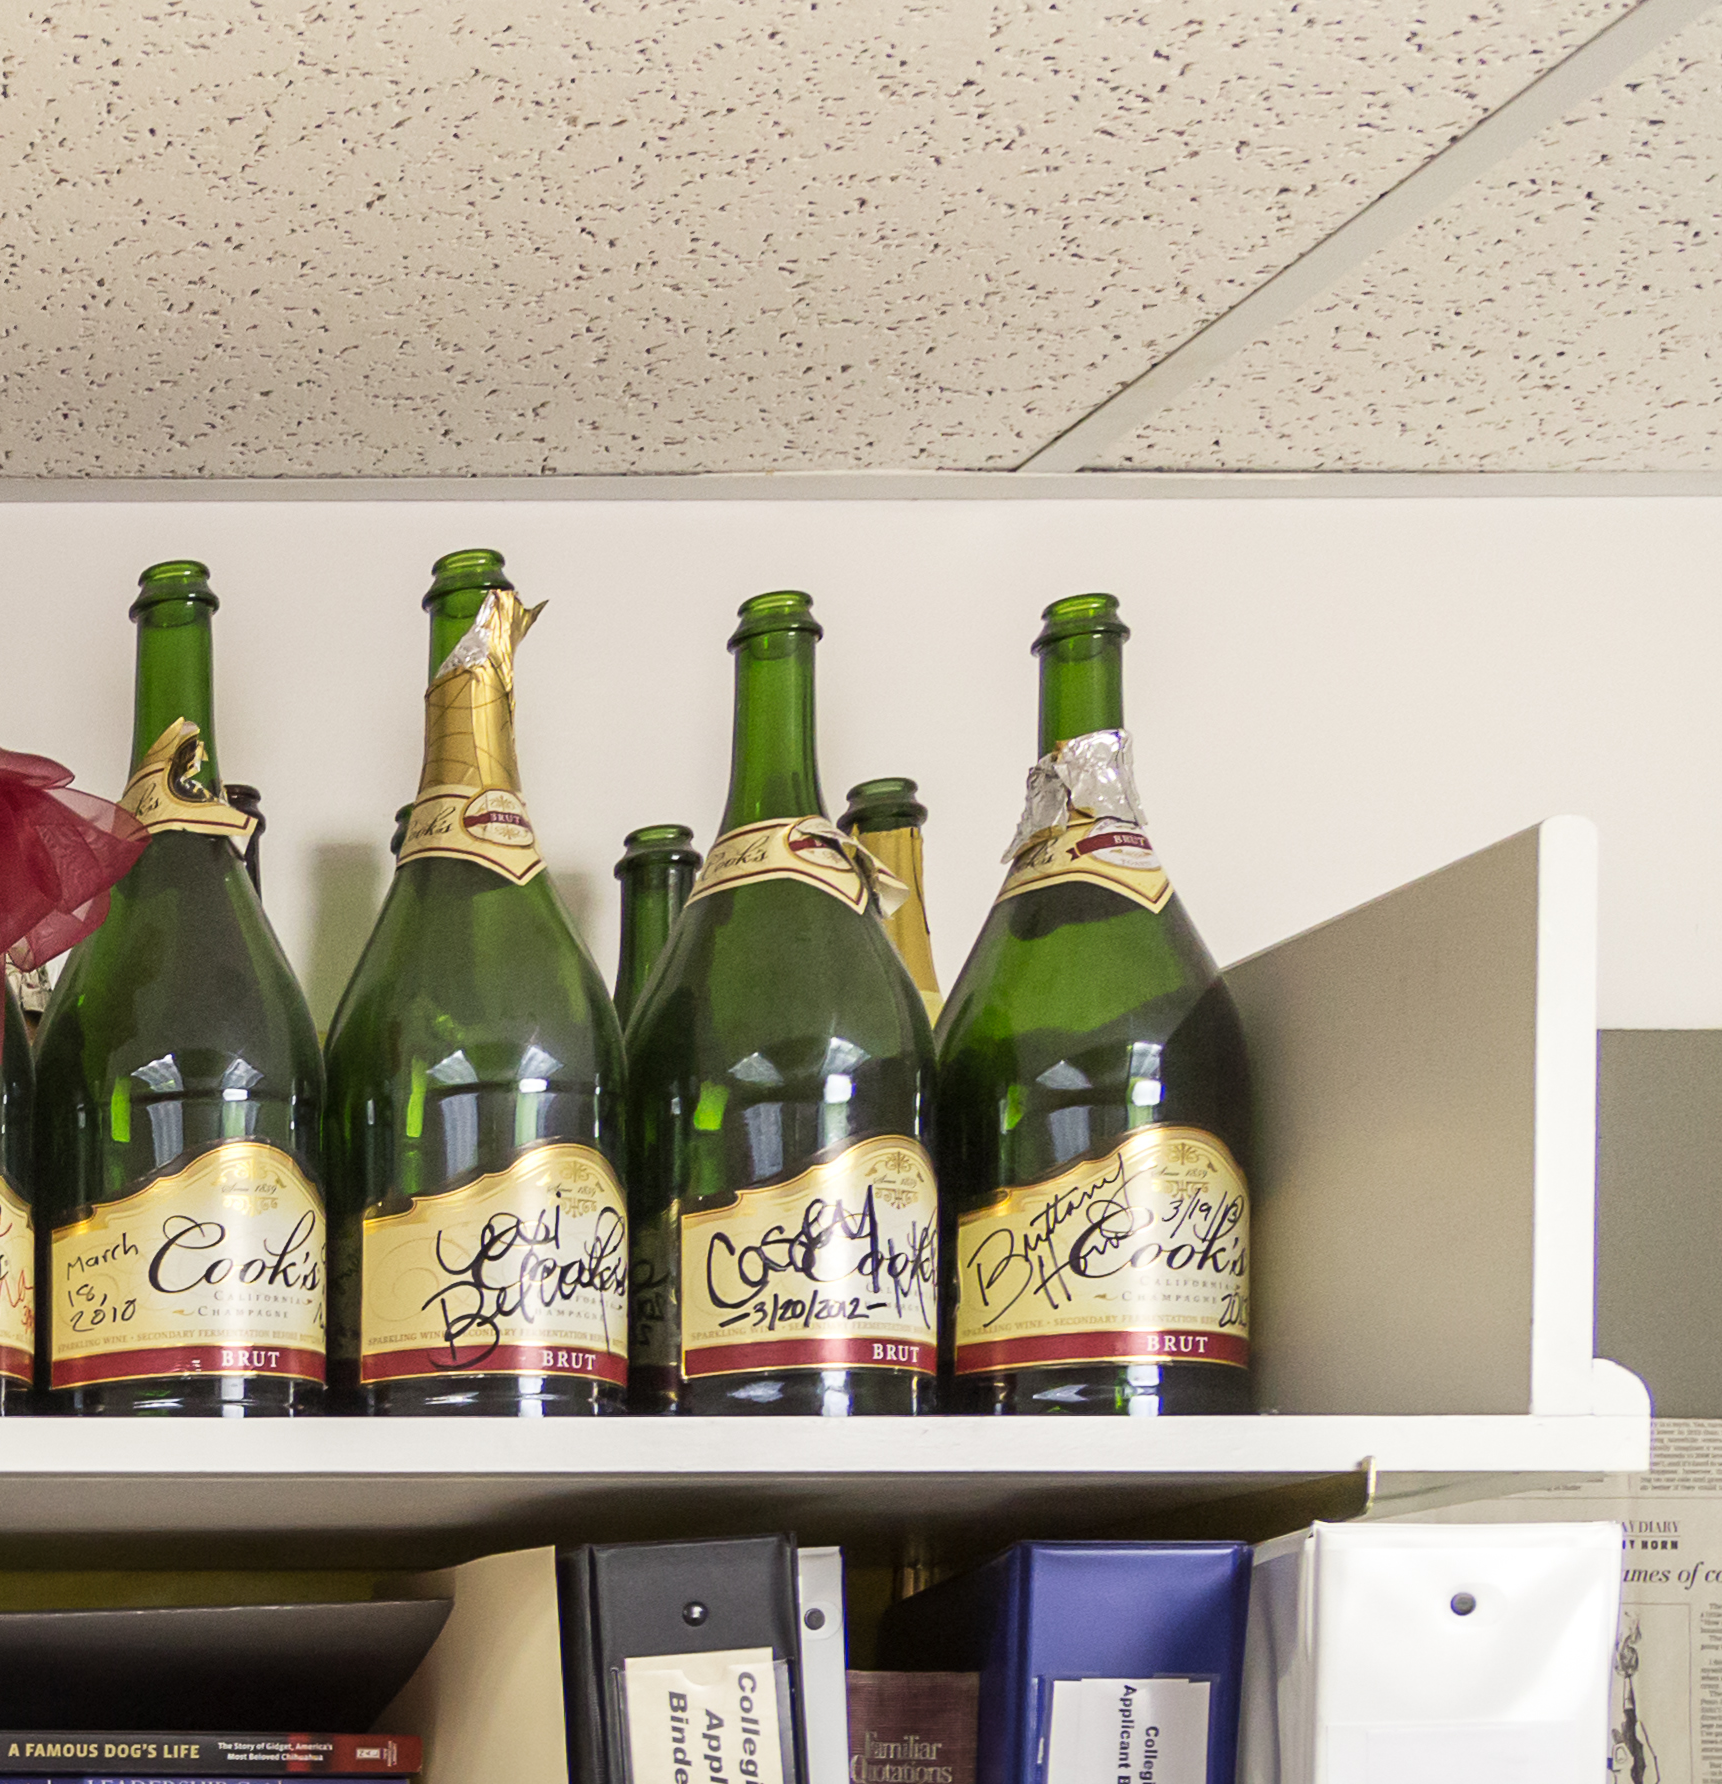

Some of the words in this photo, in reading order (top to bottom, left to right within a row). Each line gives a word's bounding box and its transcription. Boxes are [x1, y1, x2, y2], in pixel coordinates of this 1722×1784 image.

[64, 1233, 139, 1280] March
[69, 1298, 138, 1334] 2010
[872, 1342, 921, 1363] BRUT
[1147, 1334, 1209, 1355] BRUT
[221, 1349, 280, 1368] BRUT
[541, 1349, 597, 1371] BRUT
[1118, 1684, 1137, 1769] Applicant
[8, 1743, 20, 1757] A
[25, 1743, 98, 1758] FAMOUS
[104, 1744, 157, 1758] DOG'S
[163, 1745, 200, 1758] LIFE
[218, 1742, 232, 1750] The
[234, 1742, 254, 1751] Story
[256, 1742, 265, 1750] of
[296, 1743, 333, 1751] America's
[227, 1753, 247, 1761] Most
[249, 1753, 280, 1761] Beloved
[281, 1753, 323, 1761] Chihuahua
